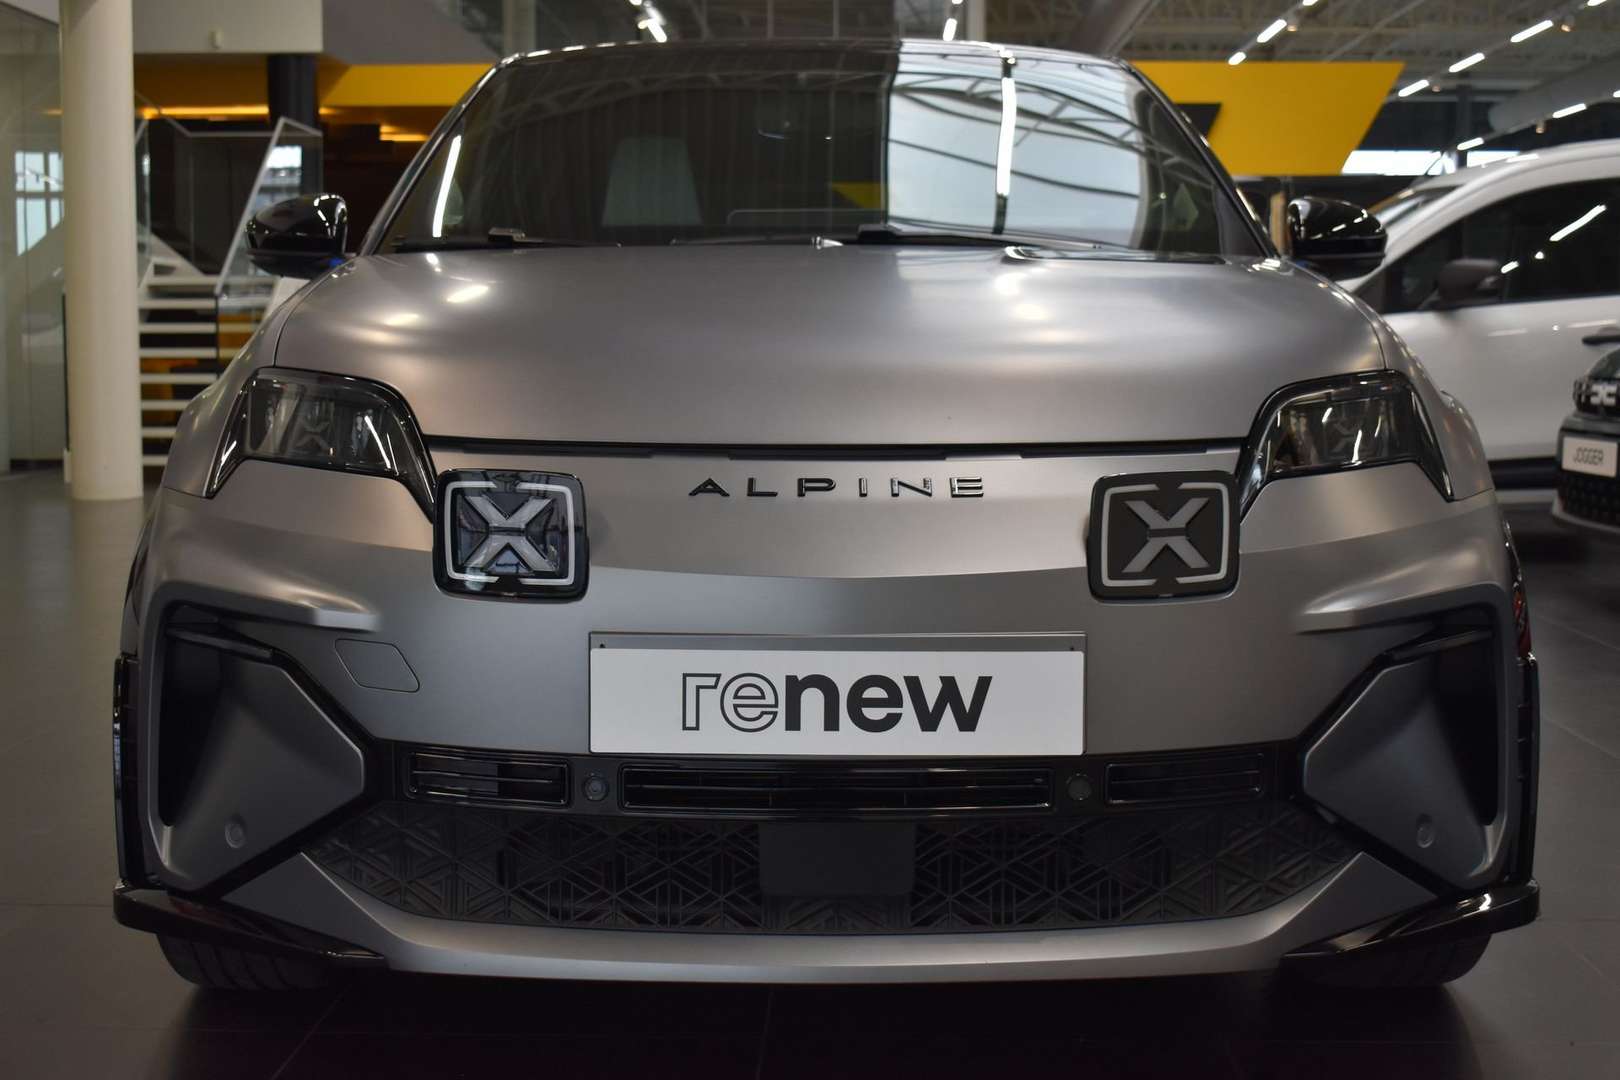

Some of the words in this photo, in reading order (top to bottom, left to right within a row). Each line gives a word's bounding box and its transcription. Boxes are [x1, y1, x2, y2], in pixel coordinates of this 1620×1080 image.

[1573, 447, 1604, 466] JOGGER
[688, 477, 985, 498] ALPINE
[681, 672, 993, 733] renew
